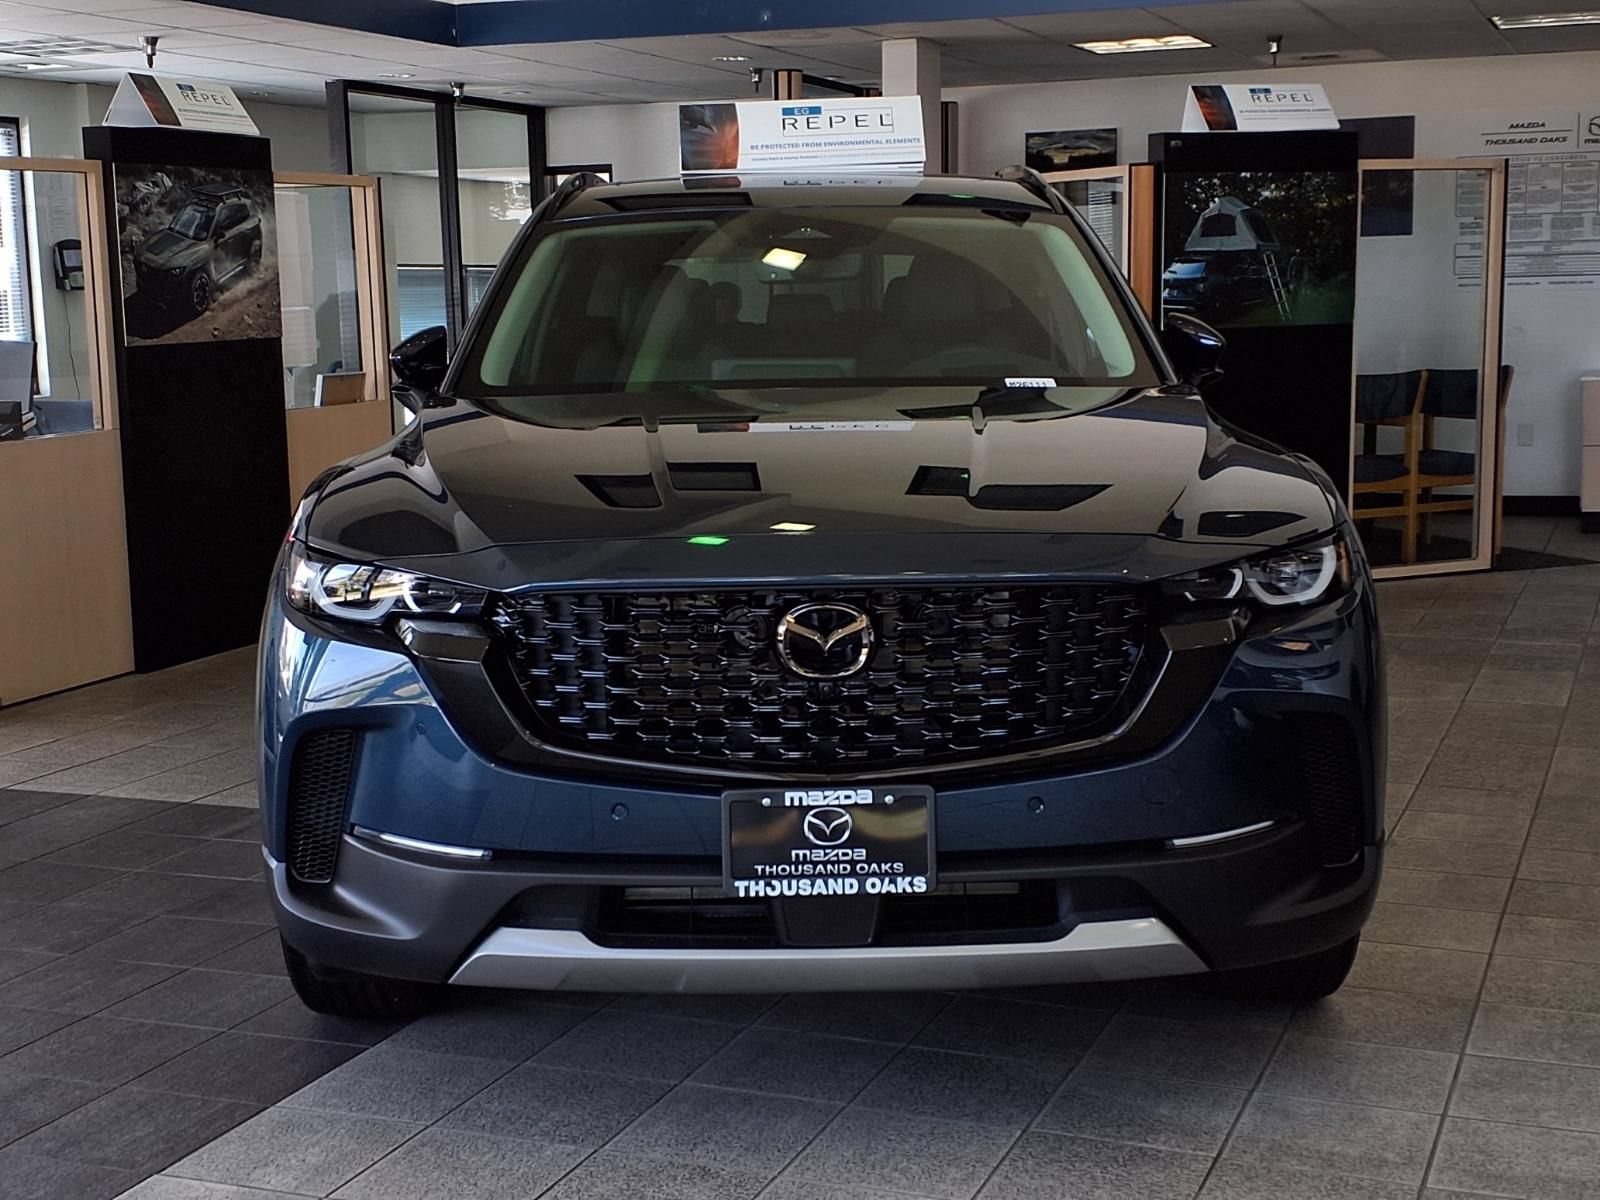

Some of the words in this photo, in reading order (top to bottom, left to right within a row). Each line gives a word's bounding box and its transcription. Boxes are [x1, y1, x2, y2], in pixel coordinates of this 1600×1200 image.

[181, 91, 231, 106] REPEL
[1251, 92, 1314, 103] REPEL
[794, 107, 810, 115] EG
[781, 113, 893, 131] REPEL
[1508, 122, 1546, 130] MAZDA
[760, 142, 800, 150] PROTECTED
[801, 141, 822, 149] FROM
[823, 139, 883, 148] ENVIRONMENTAL
[885, 137, 921, 145] ELEMENTS
[1484, 136, 1538, 146] THOUSAND
[1540, 136, 1568, 144] OAKS
[754, 863, 851, 876] THOUSAND
[856, 862, 904, 874] OAKS
[734, 878, 859, 898] THOUSAND
[865, 876, 928, 895] OAKS
